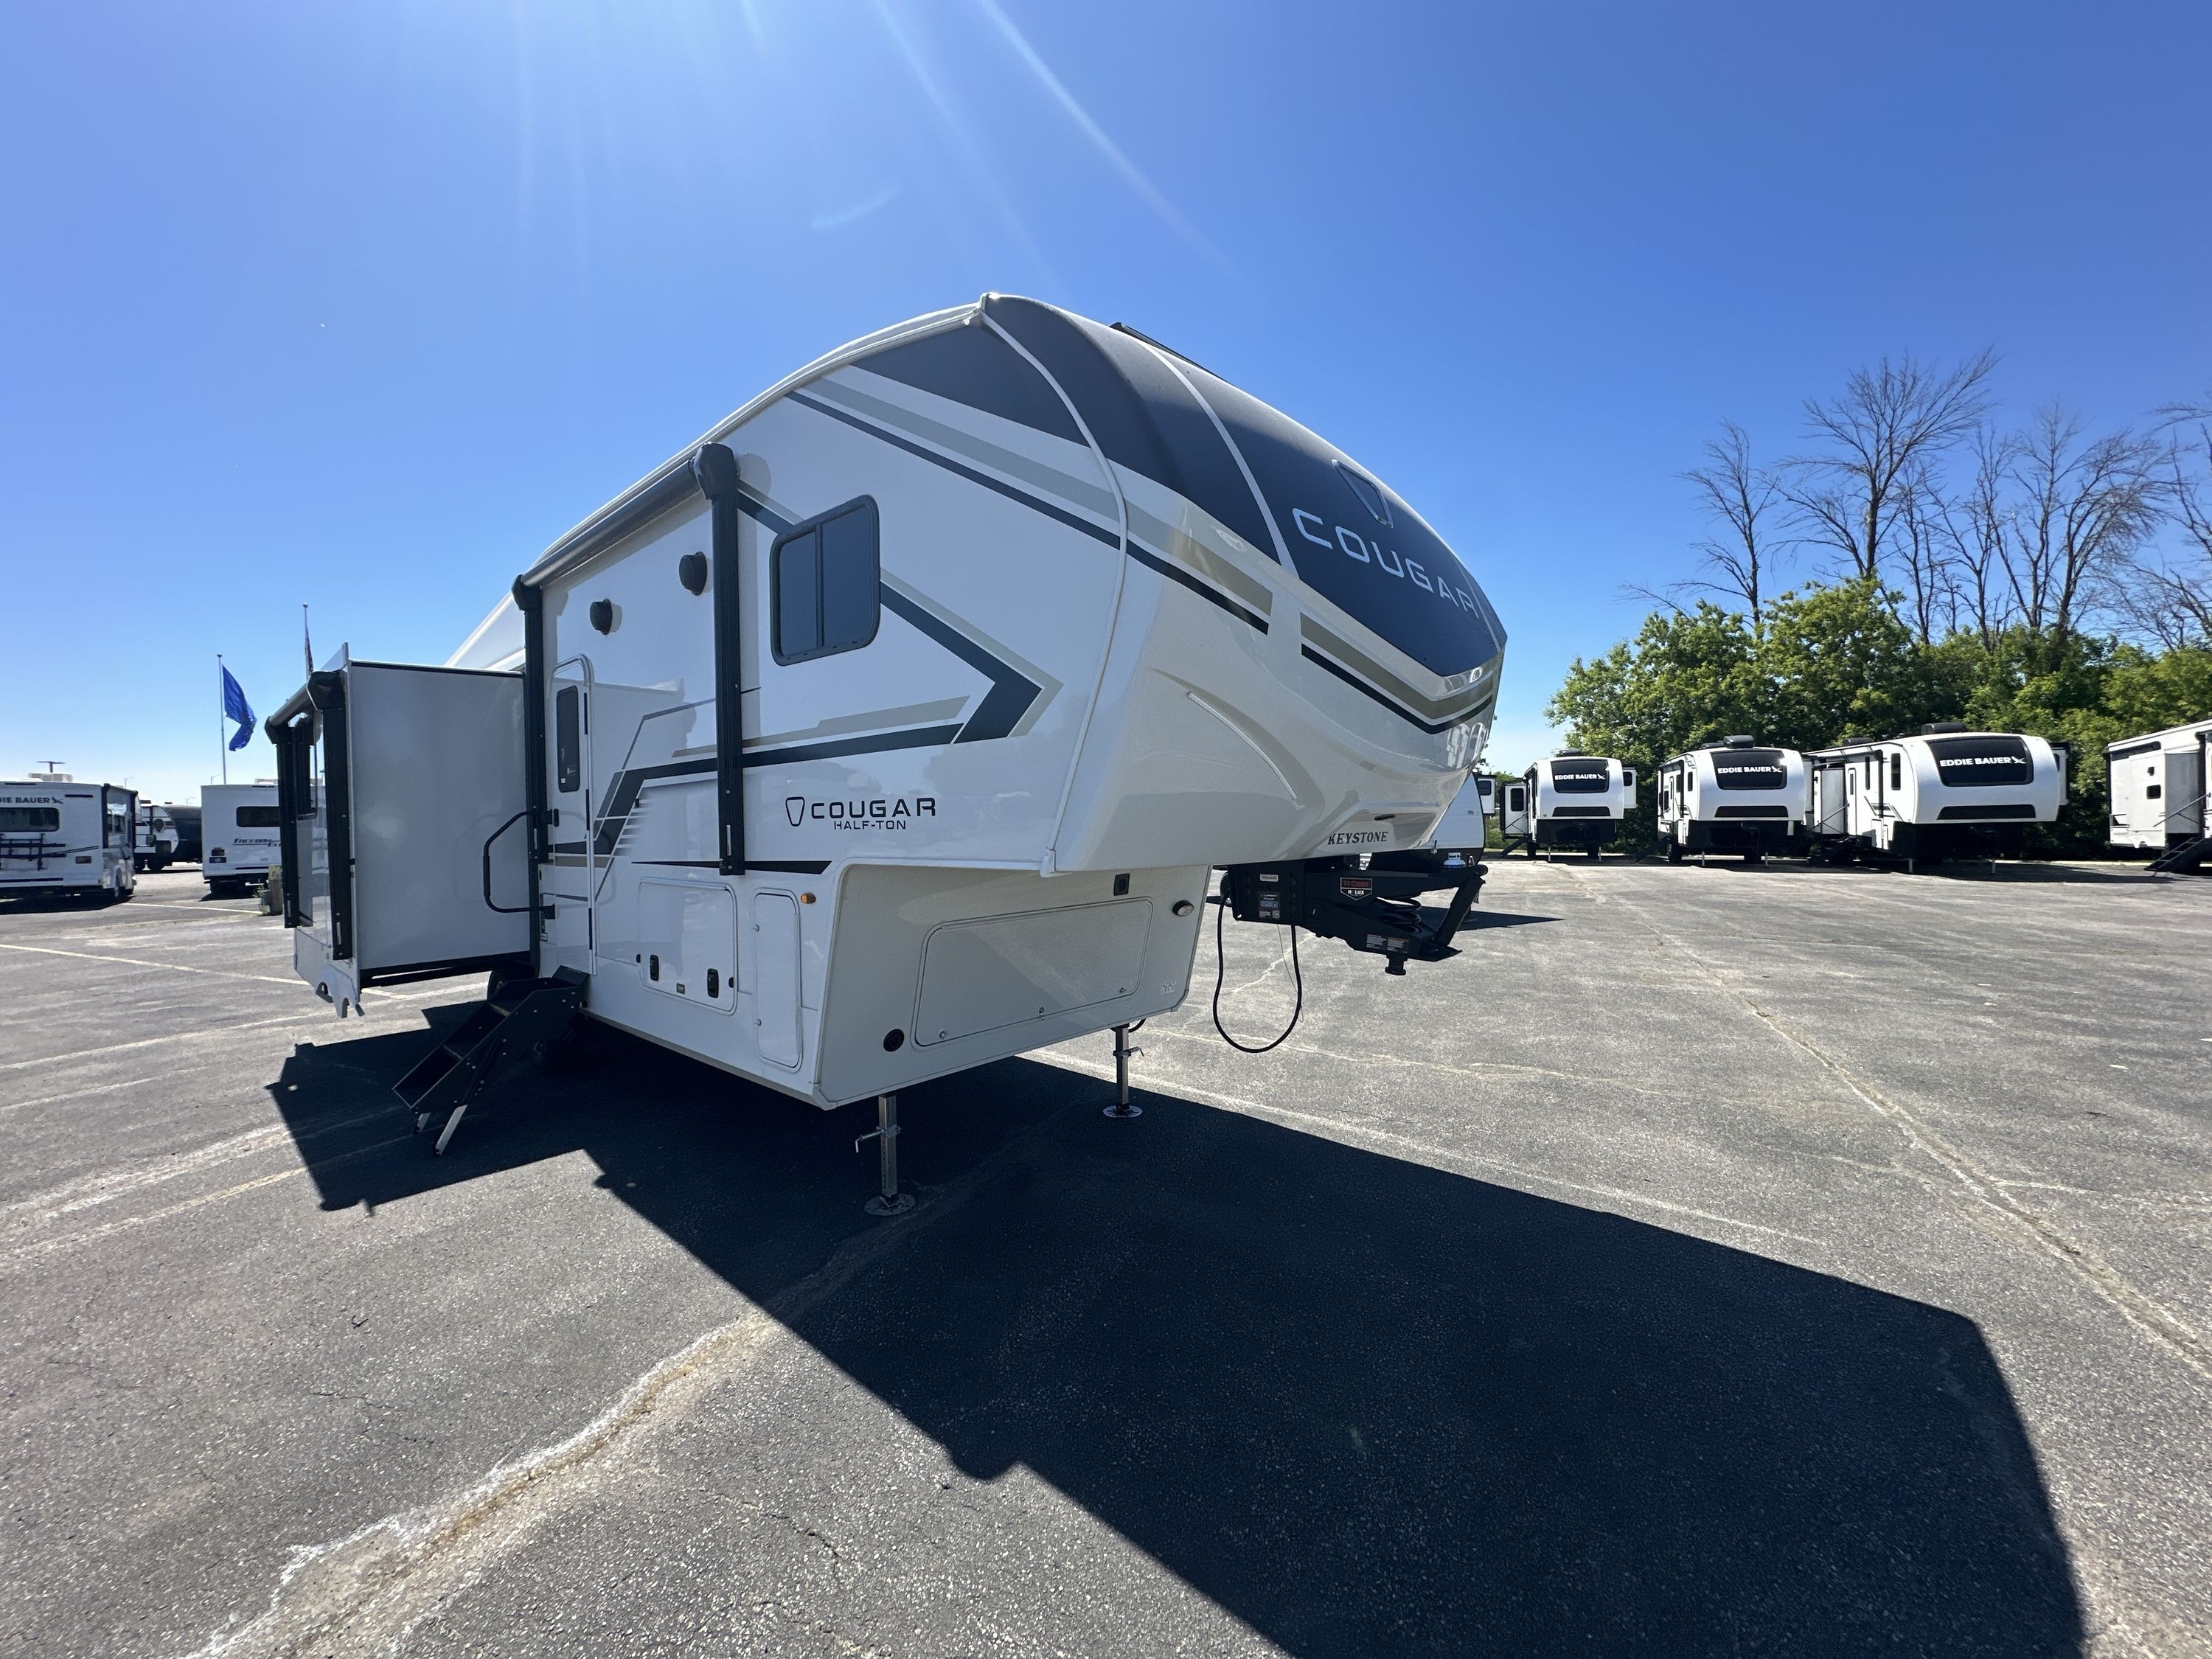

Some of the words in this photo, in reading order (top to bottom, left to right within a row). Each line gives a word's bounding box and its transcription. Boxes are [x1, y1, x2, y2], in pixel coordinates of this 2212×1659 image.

[1292, 507, 1480, 620] COUGAR
[1939, 758, 1974, 767] EDDIE
[1975, 757, 2012, 765] BAUER
[811, 797, 936, 819] COUGAR
[834, 820, 906, 830] HALF-TON
[1326, 831, 1388, 845] KEYSTONE
